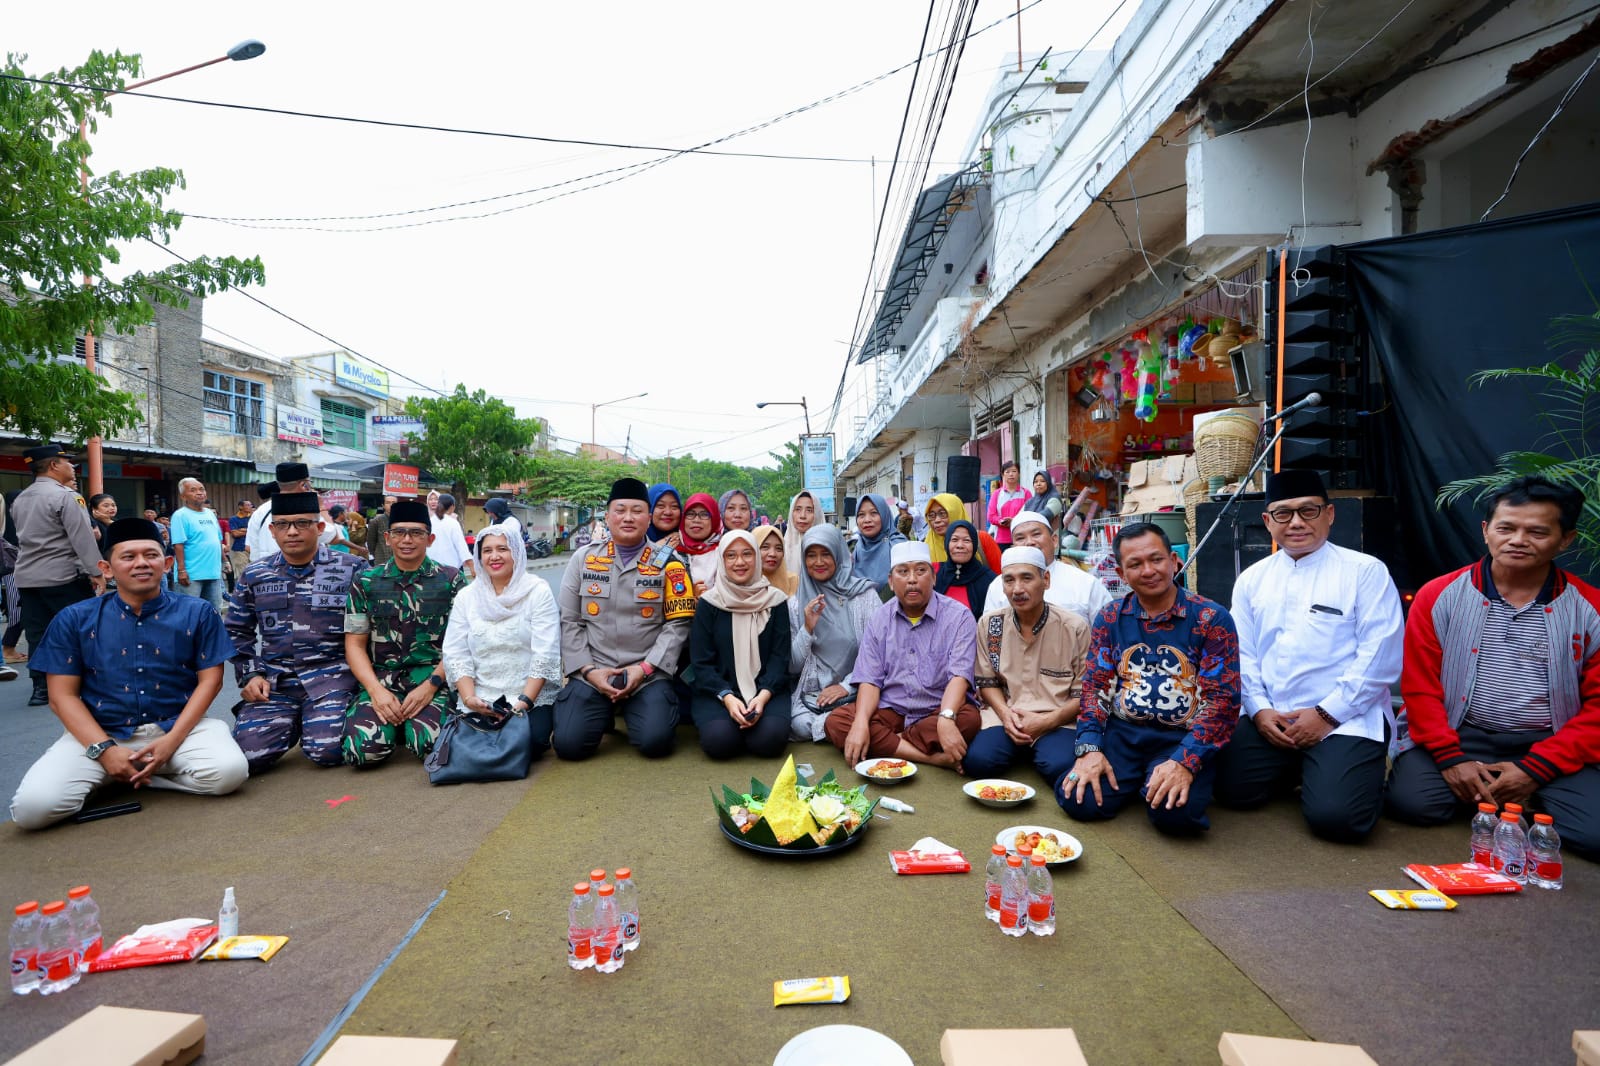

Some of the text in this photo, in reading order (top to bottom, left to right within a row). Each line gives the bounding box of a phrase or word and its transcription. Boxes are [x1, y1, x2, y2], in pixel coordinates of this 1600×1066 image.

[352, 365, 382, 386] Miyako
[635, 579, 662, 587] POLRI
[317, 584, 331, 592] TNI
